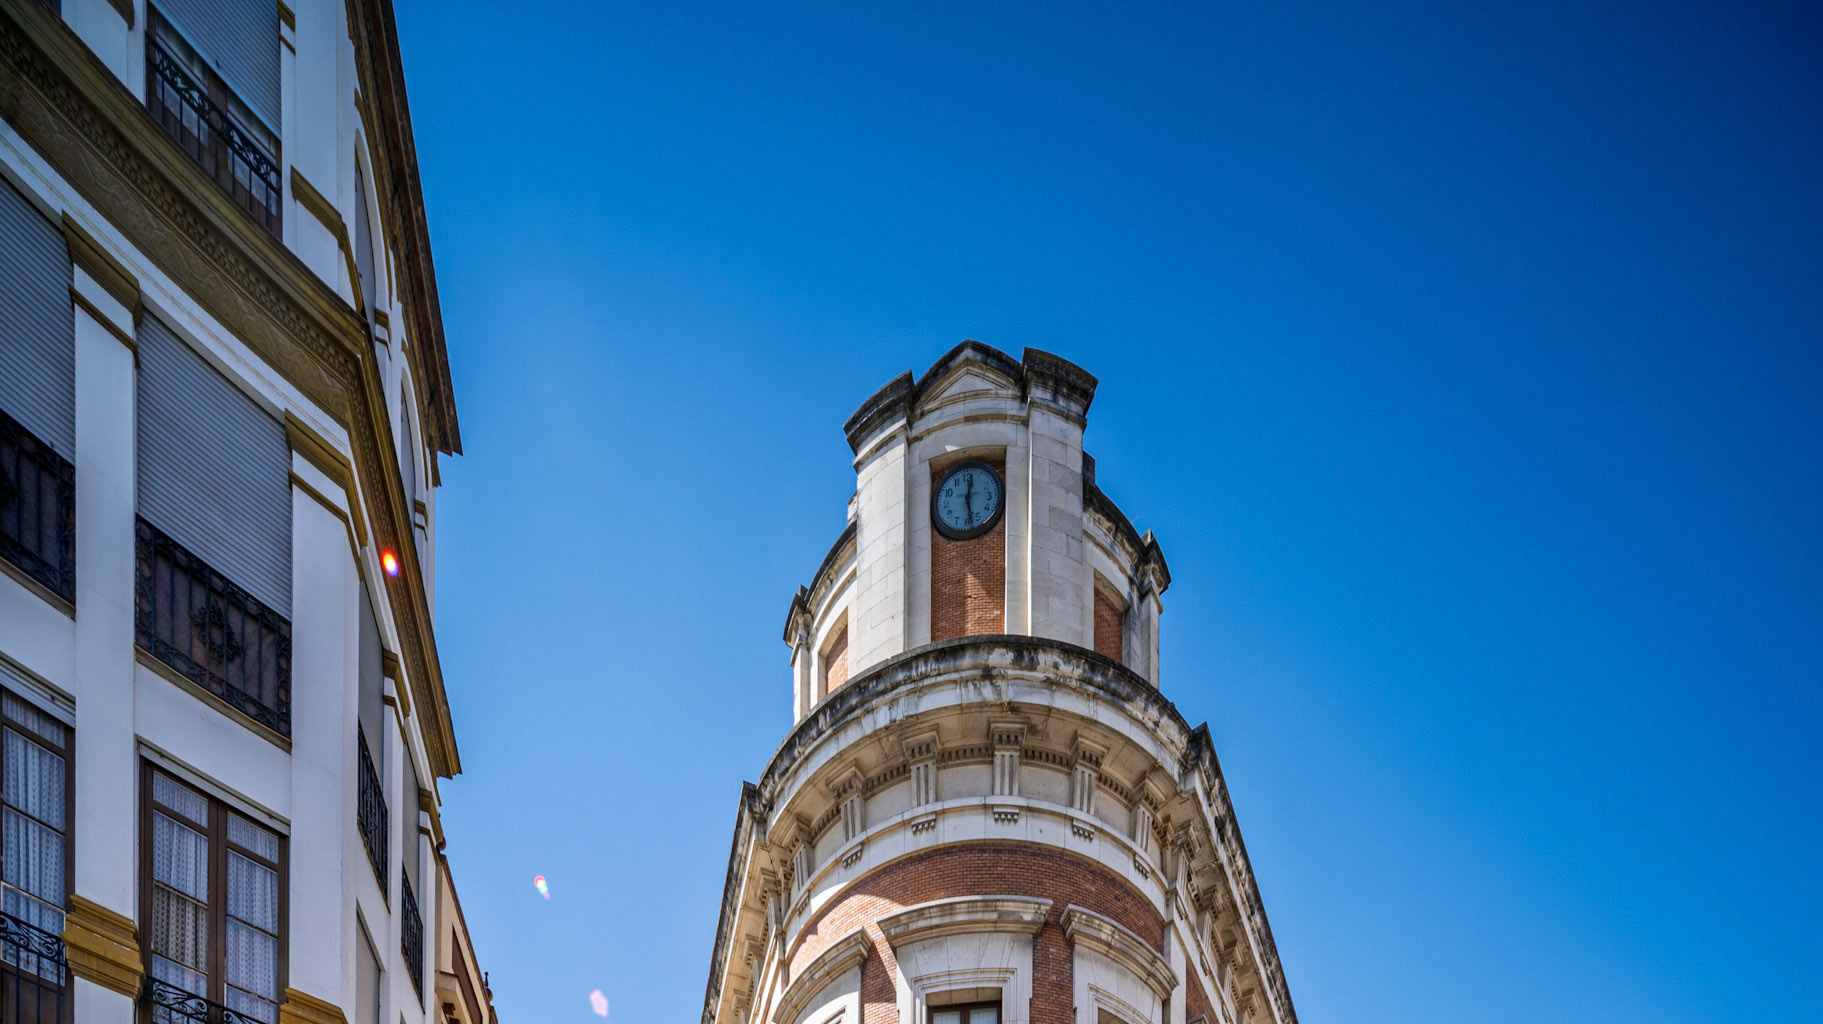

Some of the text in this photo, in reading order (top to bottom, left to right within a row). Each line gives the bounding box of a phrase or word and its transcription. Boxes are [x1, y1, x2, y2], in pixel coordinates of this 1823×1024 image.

[954, 478, 960, 487] 11
[945, 488, 953, 497] 10
[987, 491, 992, 501] 3
[954, 516, 960, 525] 7
[975, 512, 981, 521] 5
